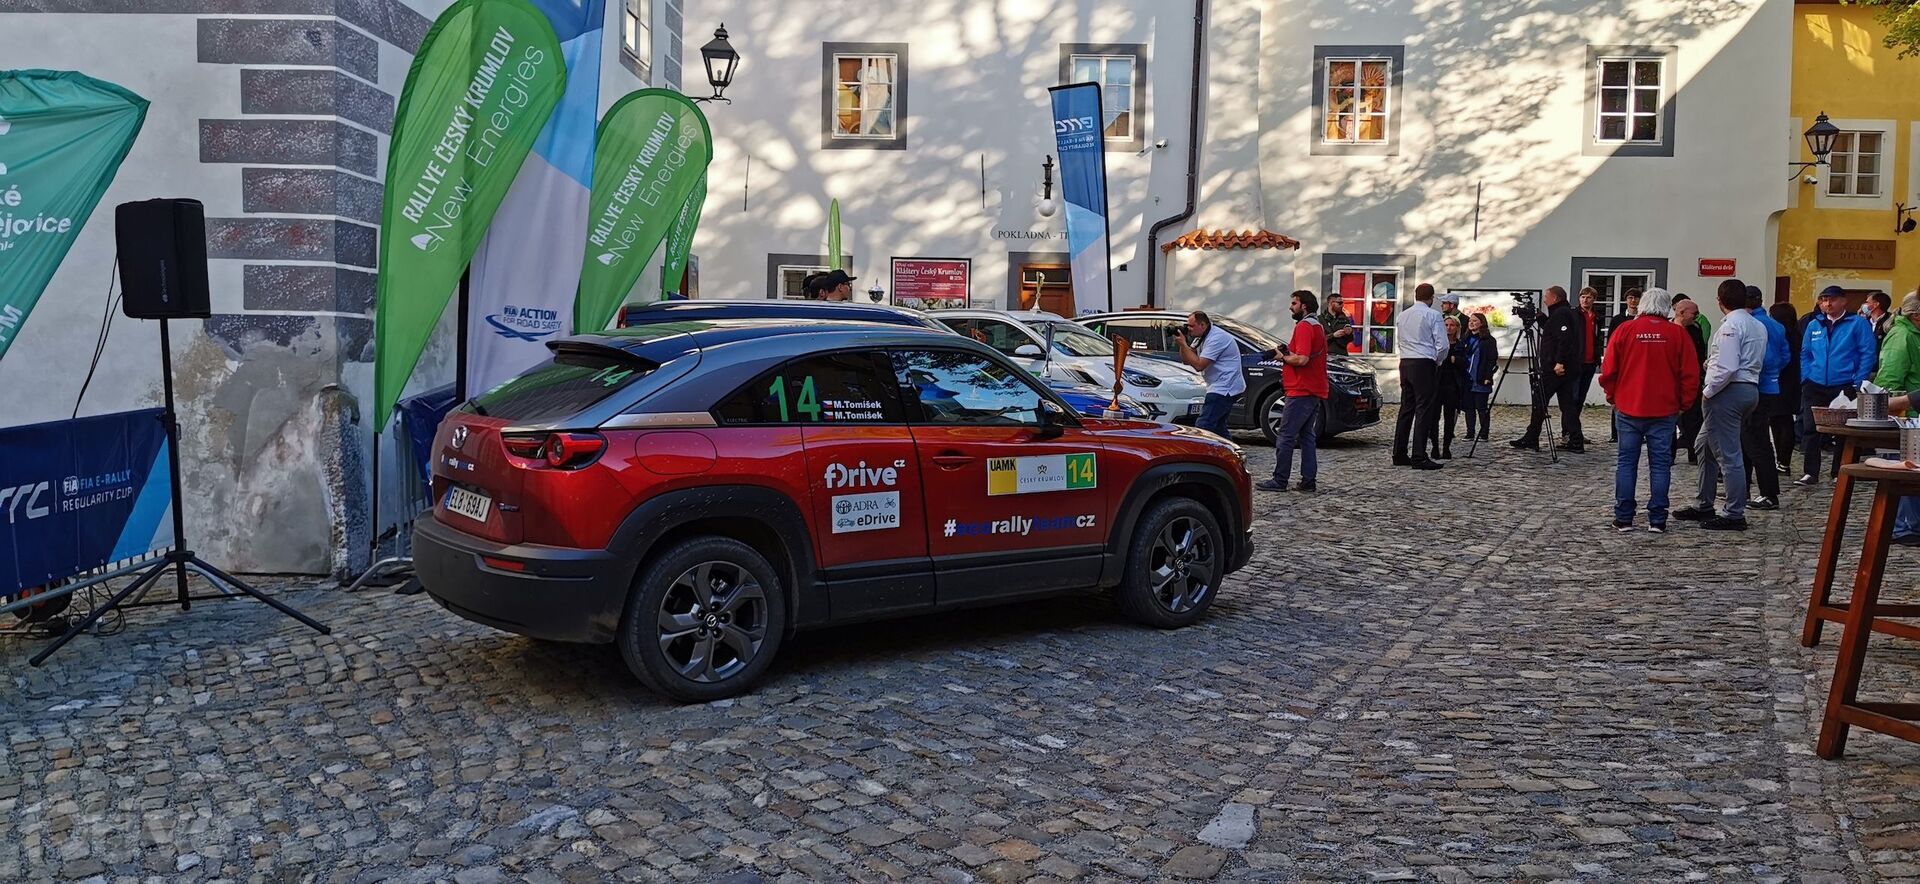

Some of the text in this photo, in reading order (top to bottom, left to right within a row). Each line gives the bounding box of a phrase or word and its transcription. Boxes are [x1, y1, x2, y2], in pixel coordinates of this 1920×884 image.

[401, 25, 515, 224] RALLYE ČESKÝ KRUMLOV
[425, 45, 544, 242] New Energies
[589, 111, 676, 247] RALLYE ČESKÝ KRUMLOV
[608, 124, 698, 261] New Energies
[997, 230, 1051, 240] POKLADNA
[920, 266, 937, 276] Český
[938, 267, 963, 275] Krumlov
[502, 316, 516, 324] FOR
[516, 318, 541, 329] ROAD
[519, 308, 558, 321] ACTION
[590, 364, 634, 388] 14
[769, 375, 821, 422] 14
[80, 478, 94, 490] FIA
[96, 470, 131, 487] E-RALLY
[824, 460, 897, 489] fDrive
[990, 458, 1094, 483] UAMK 14
[1037, 474, 1064, 483] KRUMLOV
[62, 486, 133, 513] REGULARITY CUP
[853, 500, 879, 512] ADRA
[857, 512, 896, 526] eDrive
